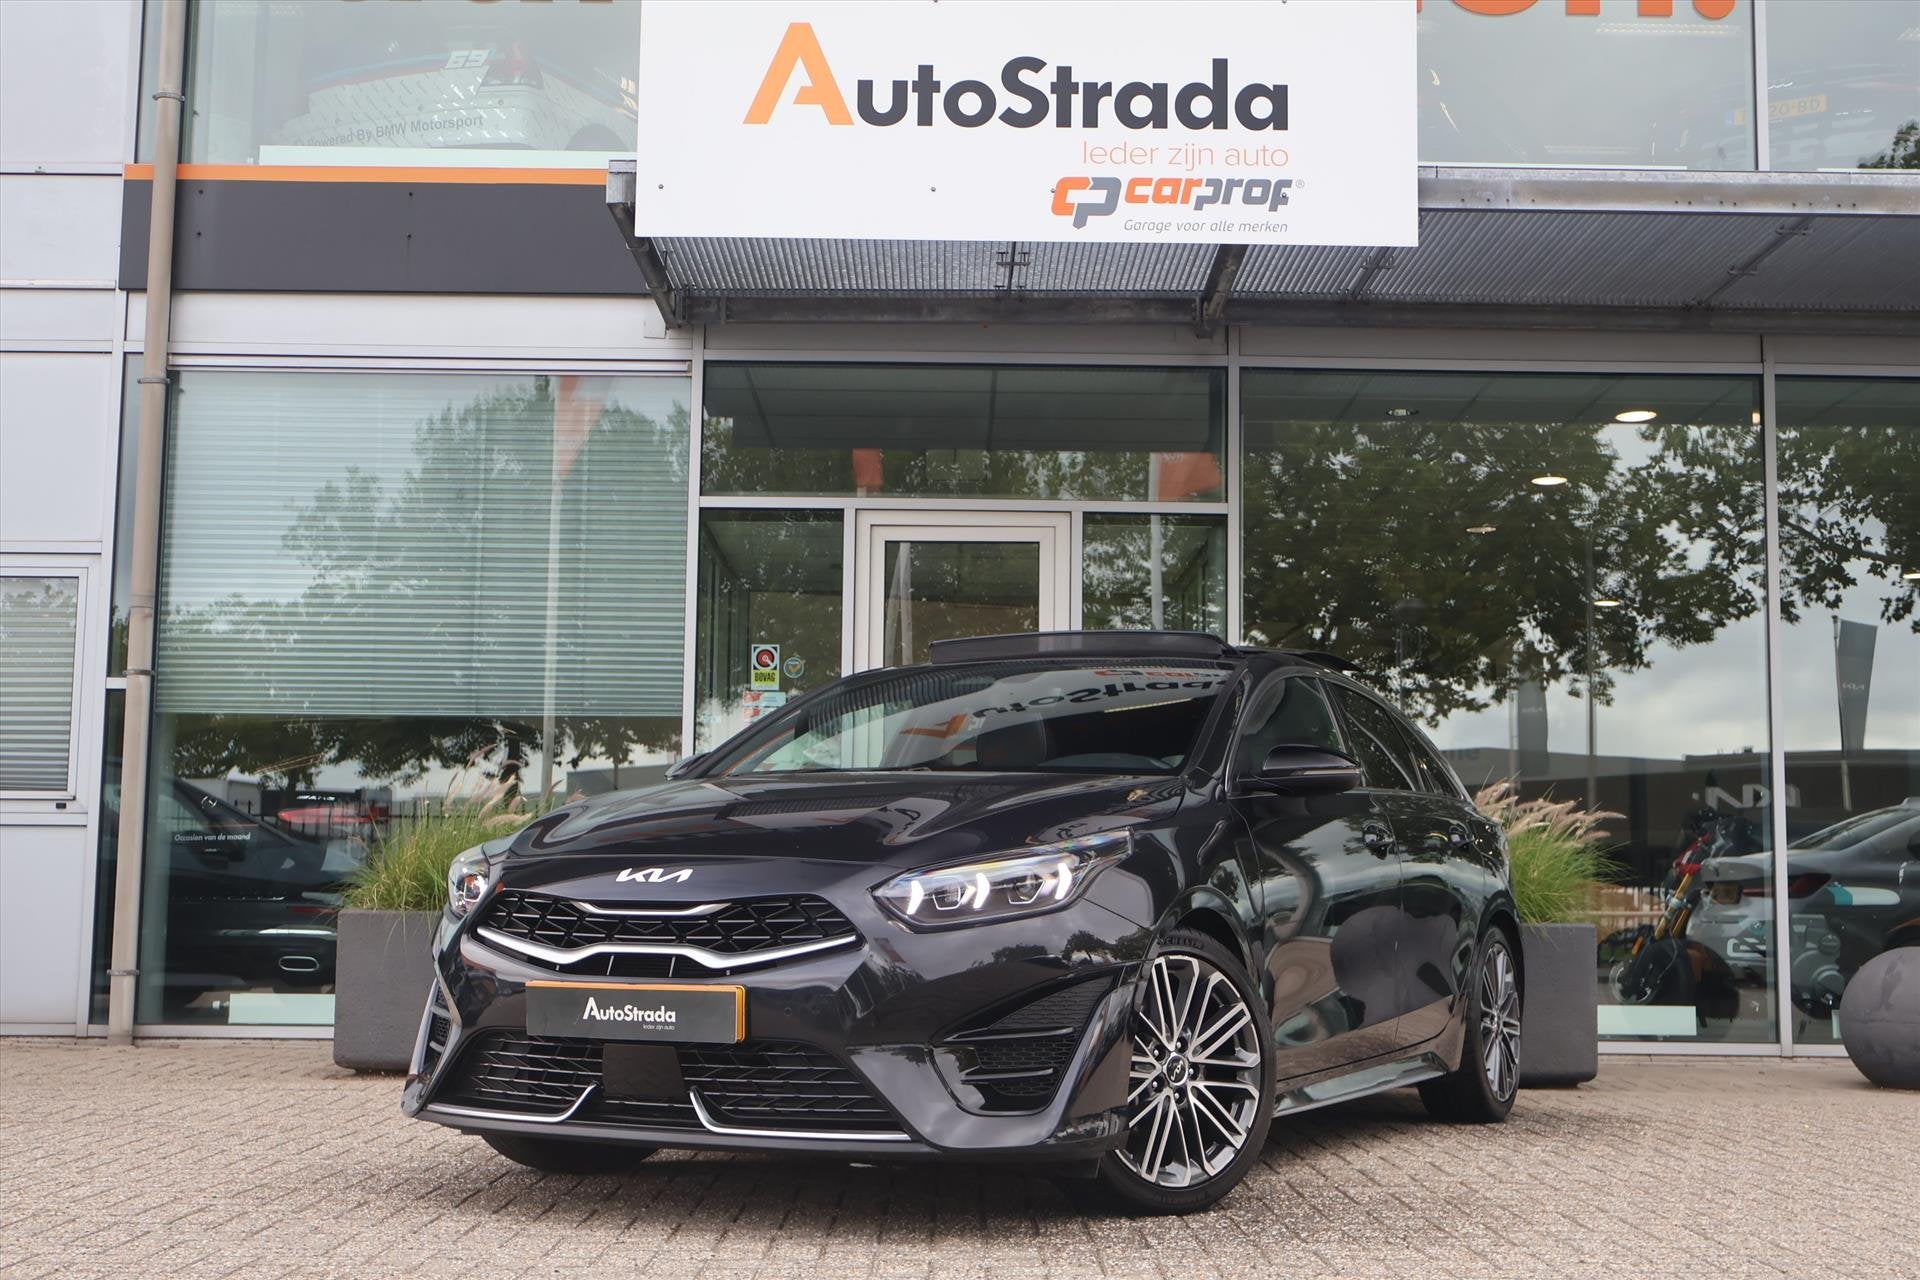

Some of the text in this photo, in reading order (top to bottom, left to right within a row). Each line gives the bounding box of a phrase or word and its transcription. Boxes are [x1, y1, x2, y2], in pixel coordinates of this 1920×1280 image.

[743, 22, 1289, 131] AutoStrada
[356, 129, 372, 143] By
[376, 122, 408, 138] BMW
[410, 113, 484, 131] Motorsport
[1083, 141, 1289, 172] Ieder zijn auto
[1123, 219, 1288, 234] Garage voor alle merken
[217, 832, 226, 841] de
[615, 867, 694, 883] KIA
[582, 996, 676, 1023] AutoStrada
